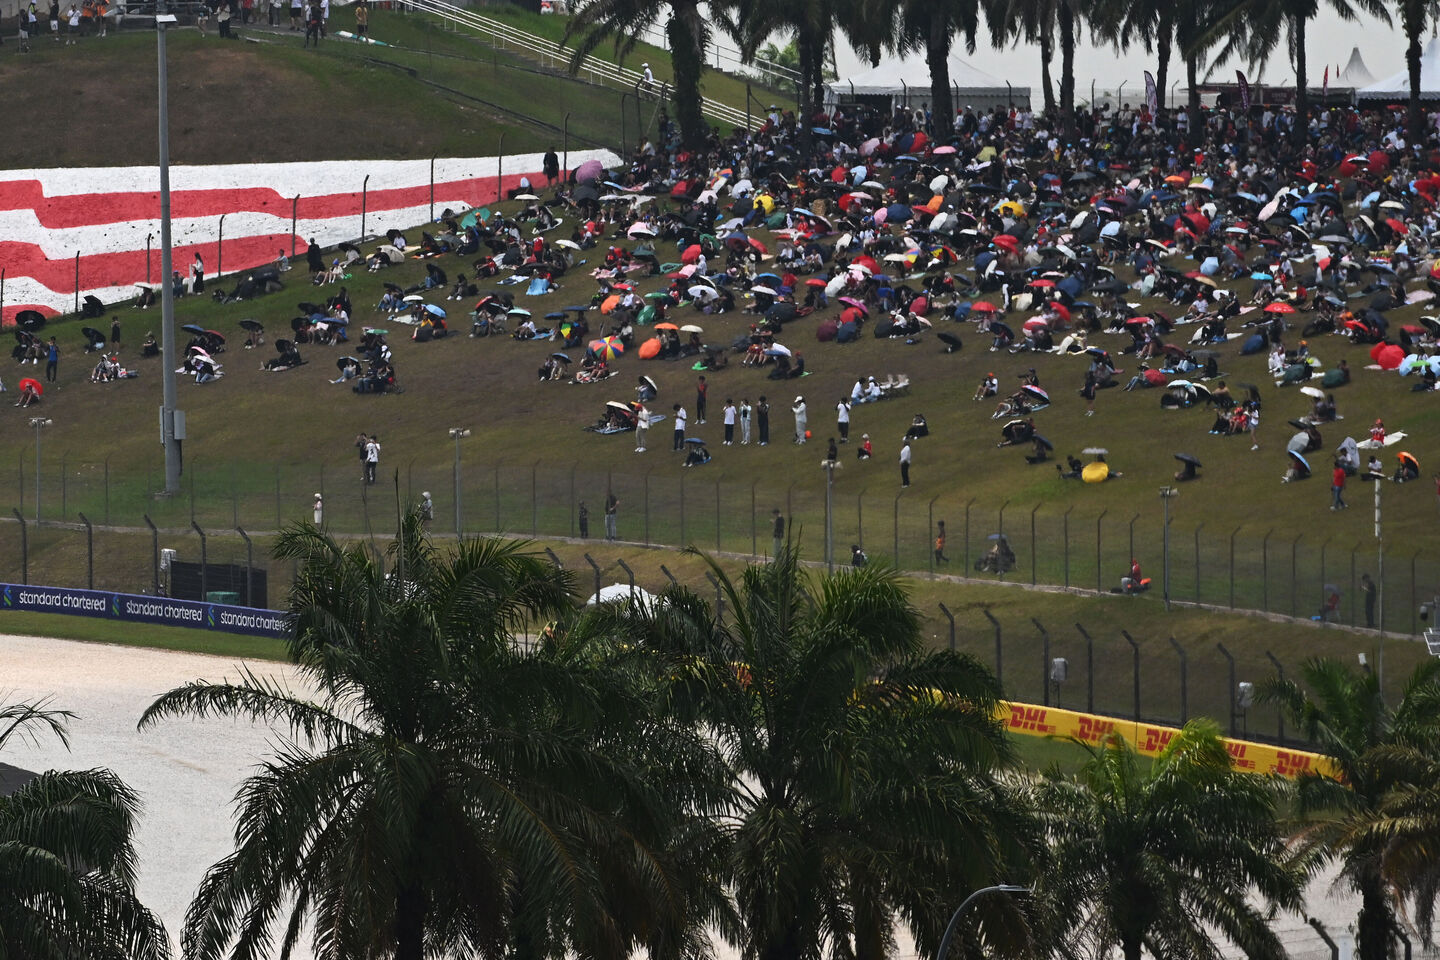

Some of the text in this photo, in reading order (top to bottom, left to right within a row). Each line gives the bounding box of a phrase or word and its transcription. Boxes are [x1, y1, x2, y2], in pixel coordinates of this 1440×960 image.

[19, 590, 106, 611] standard chartered
[126, 600, 203, 621] standard chartered
[220, 610, 255, 628] standard
[1010, 705, 1049, 733] DHL
[1145, 728, 1174, 752] DH
[1224, 742, 1249, 769] HL
